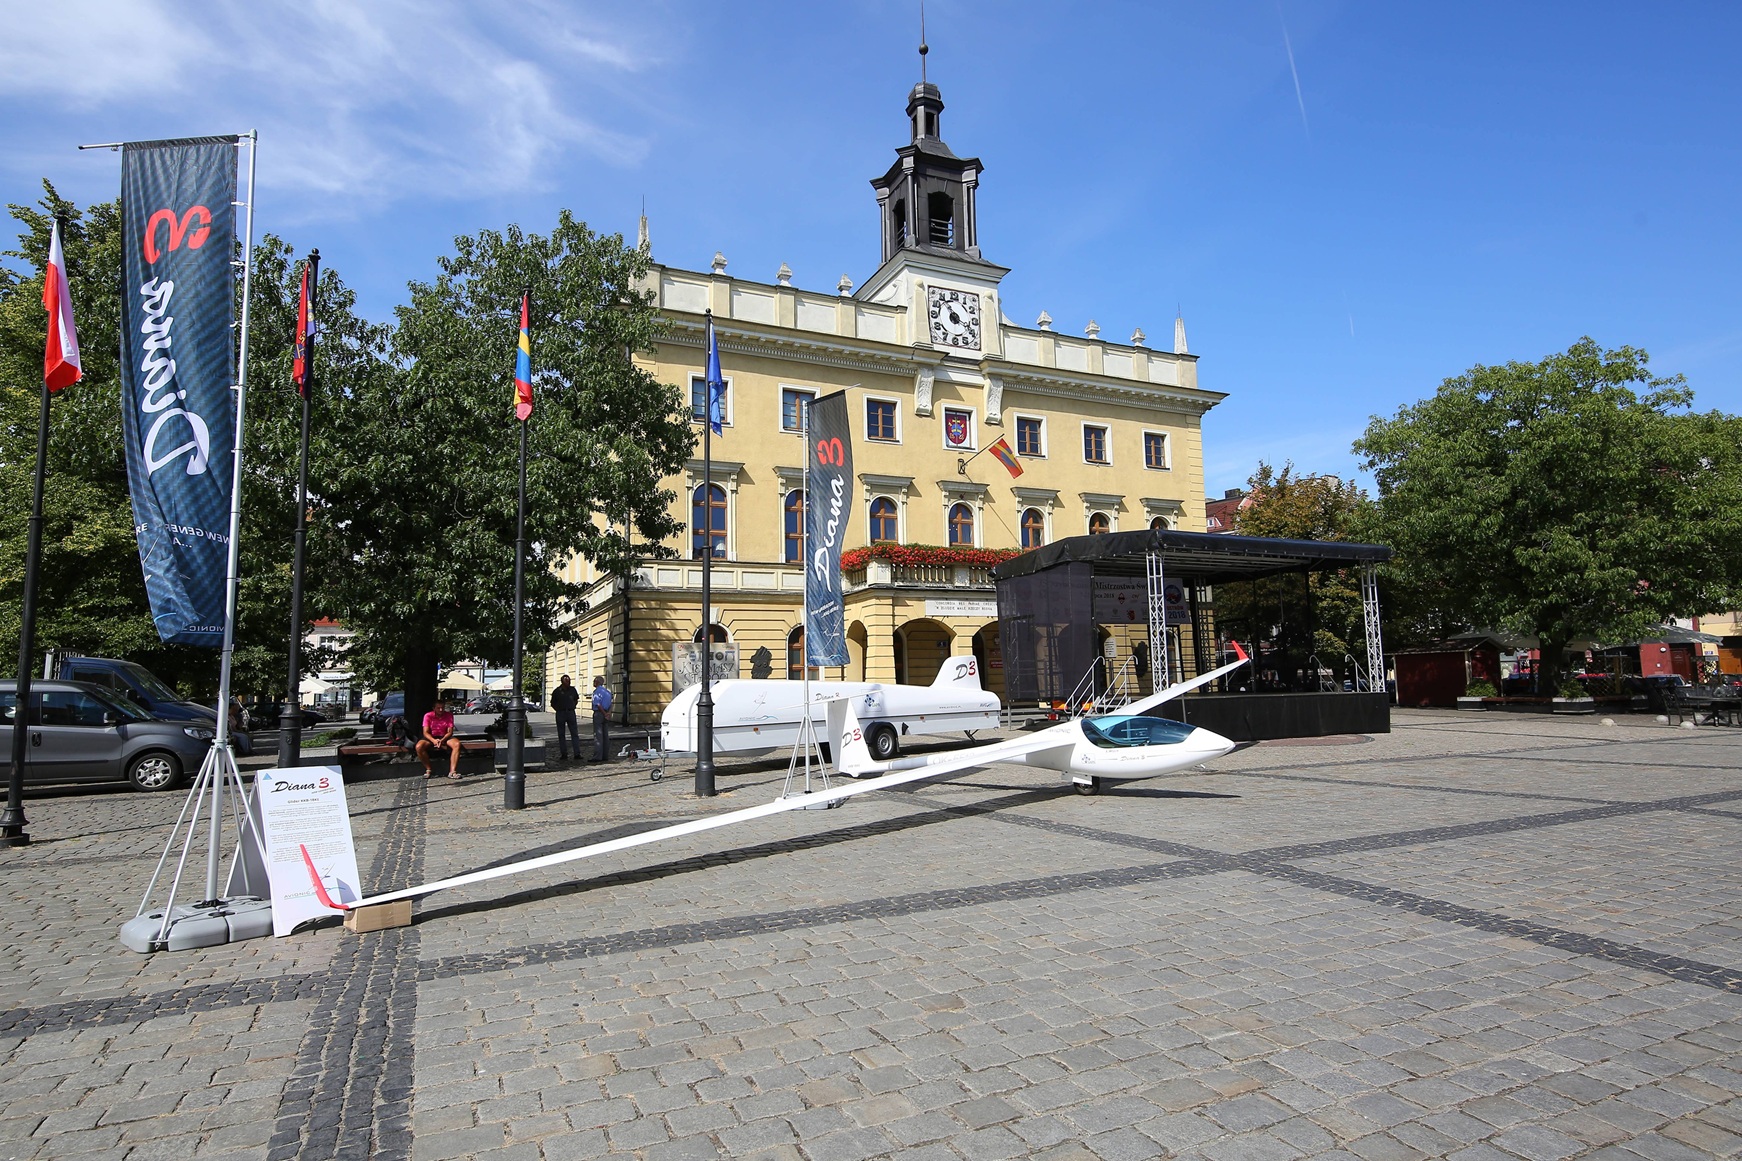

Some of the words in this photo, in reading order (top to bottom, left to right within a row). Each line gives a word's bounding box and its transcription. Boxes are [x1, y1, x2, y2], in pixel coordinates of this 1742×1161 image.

[817, 436, 845, 467] 3
[814, 473, 845, 592] Diana
[1168, 611, 1186, 619] 2018
[678, 662, 734, 674] KIEMASZ
[270, 780, 316, 793] Diana
[319, 777, 330, 788] 3
